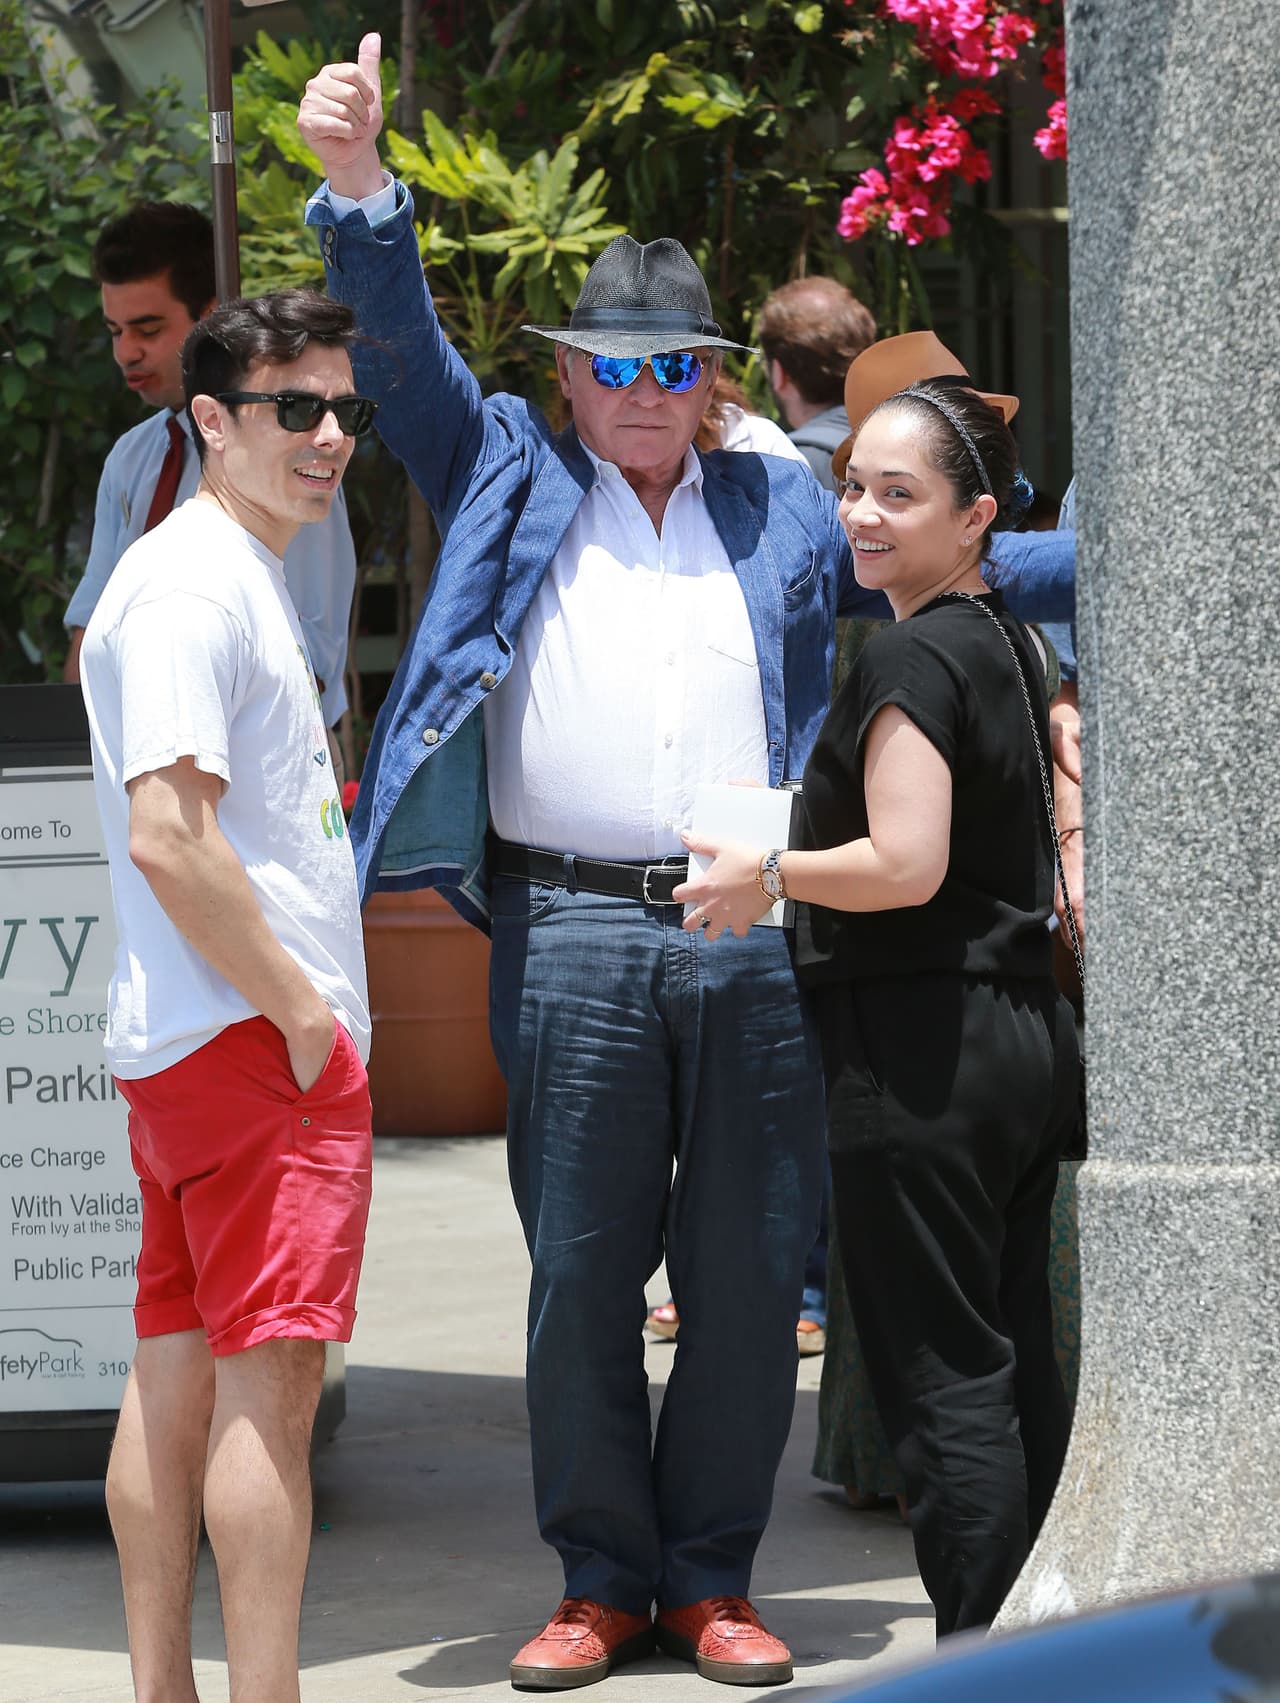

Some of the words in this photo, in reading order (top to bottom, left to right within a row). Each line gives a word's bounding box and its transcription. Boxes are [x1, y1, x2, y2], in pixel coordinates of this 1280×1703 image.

[0, 825, 42, 840] ome
[48, 820, 71, 838] To
[6, 1064, 117, 1104] Parki
[31, 1147, 105, 1171] Charge
[11, 1194, 62, 1218] With
[11, 1222, 46, 1236] From
[50, 1221, 69, 1237] Ivy
[73, 1221, 86, 1234] at
[90, 1220, 111, 1233] the
[115, 1218, 141, 1233] Sho
[14, 1257, 84, 1280] Public
